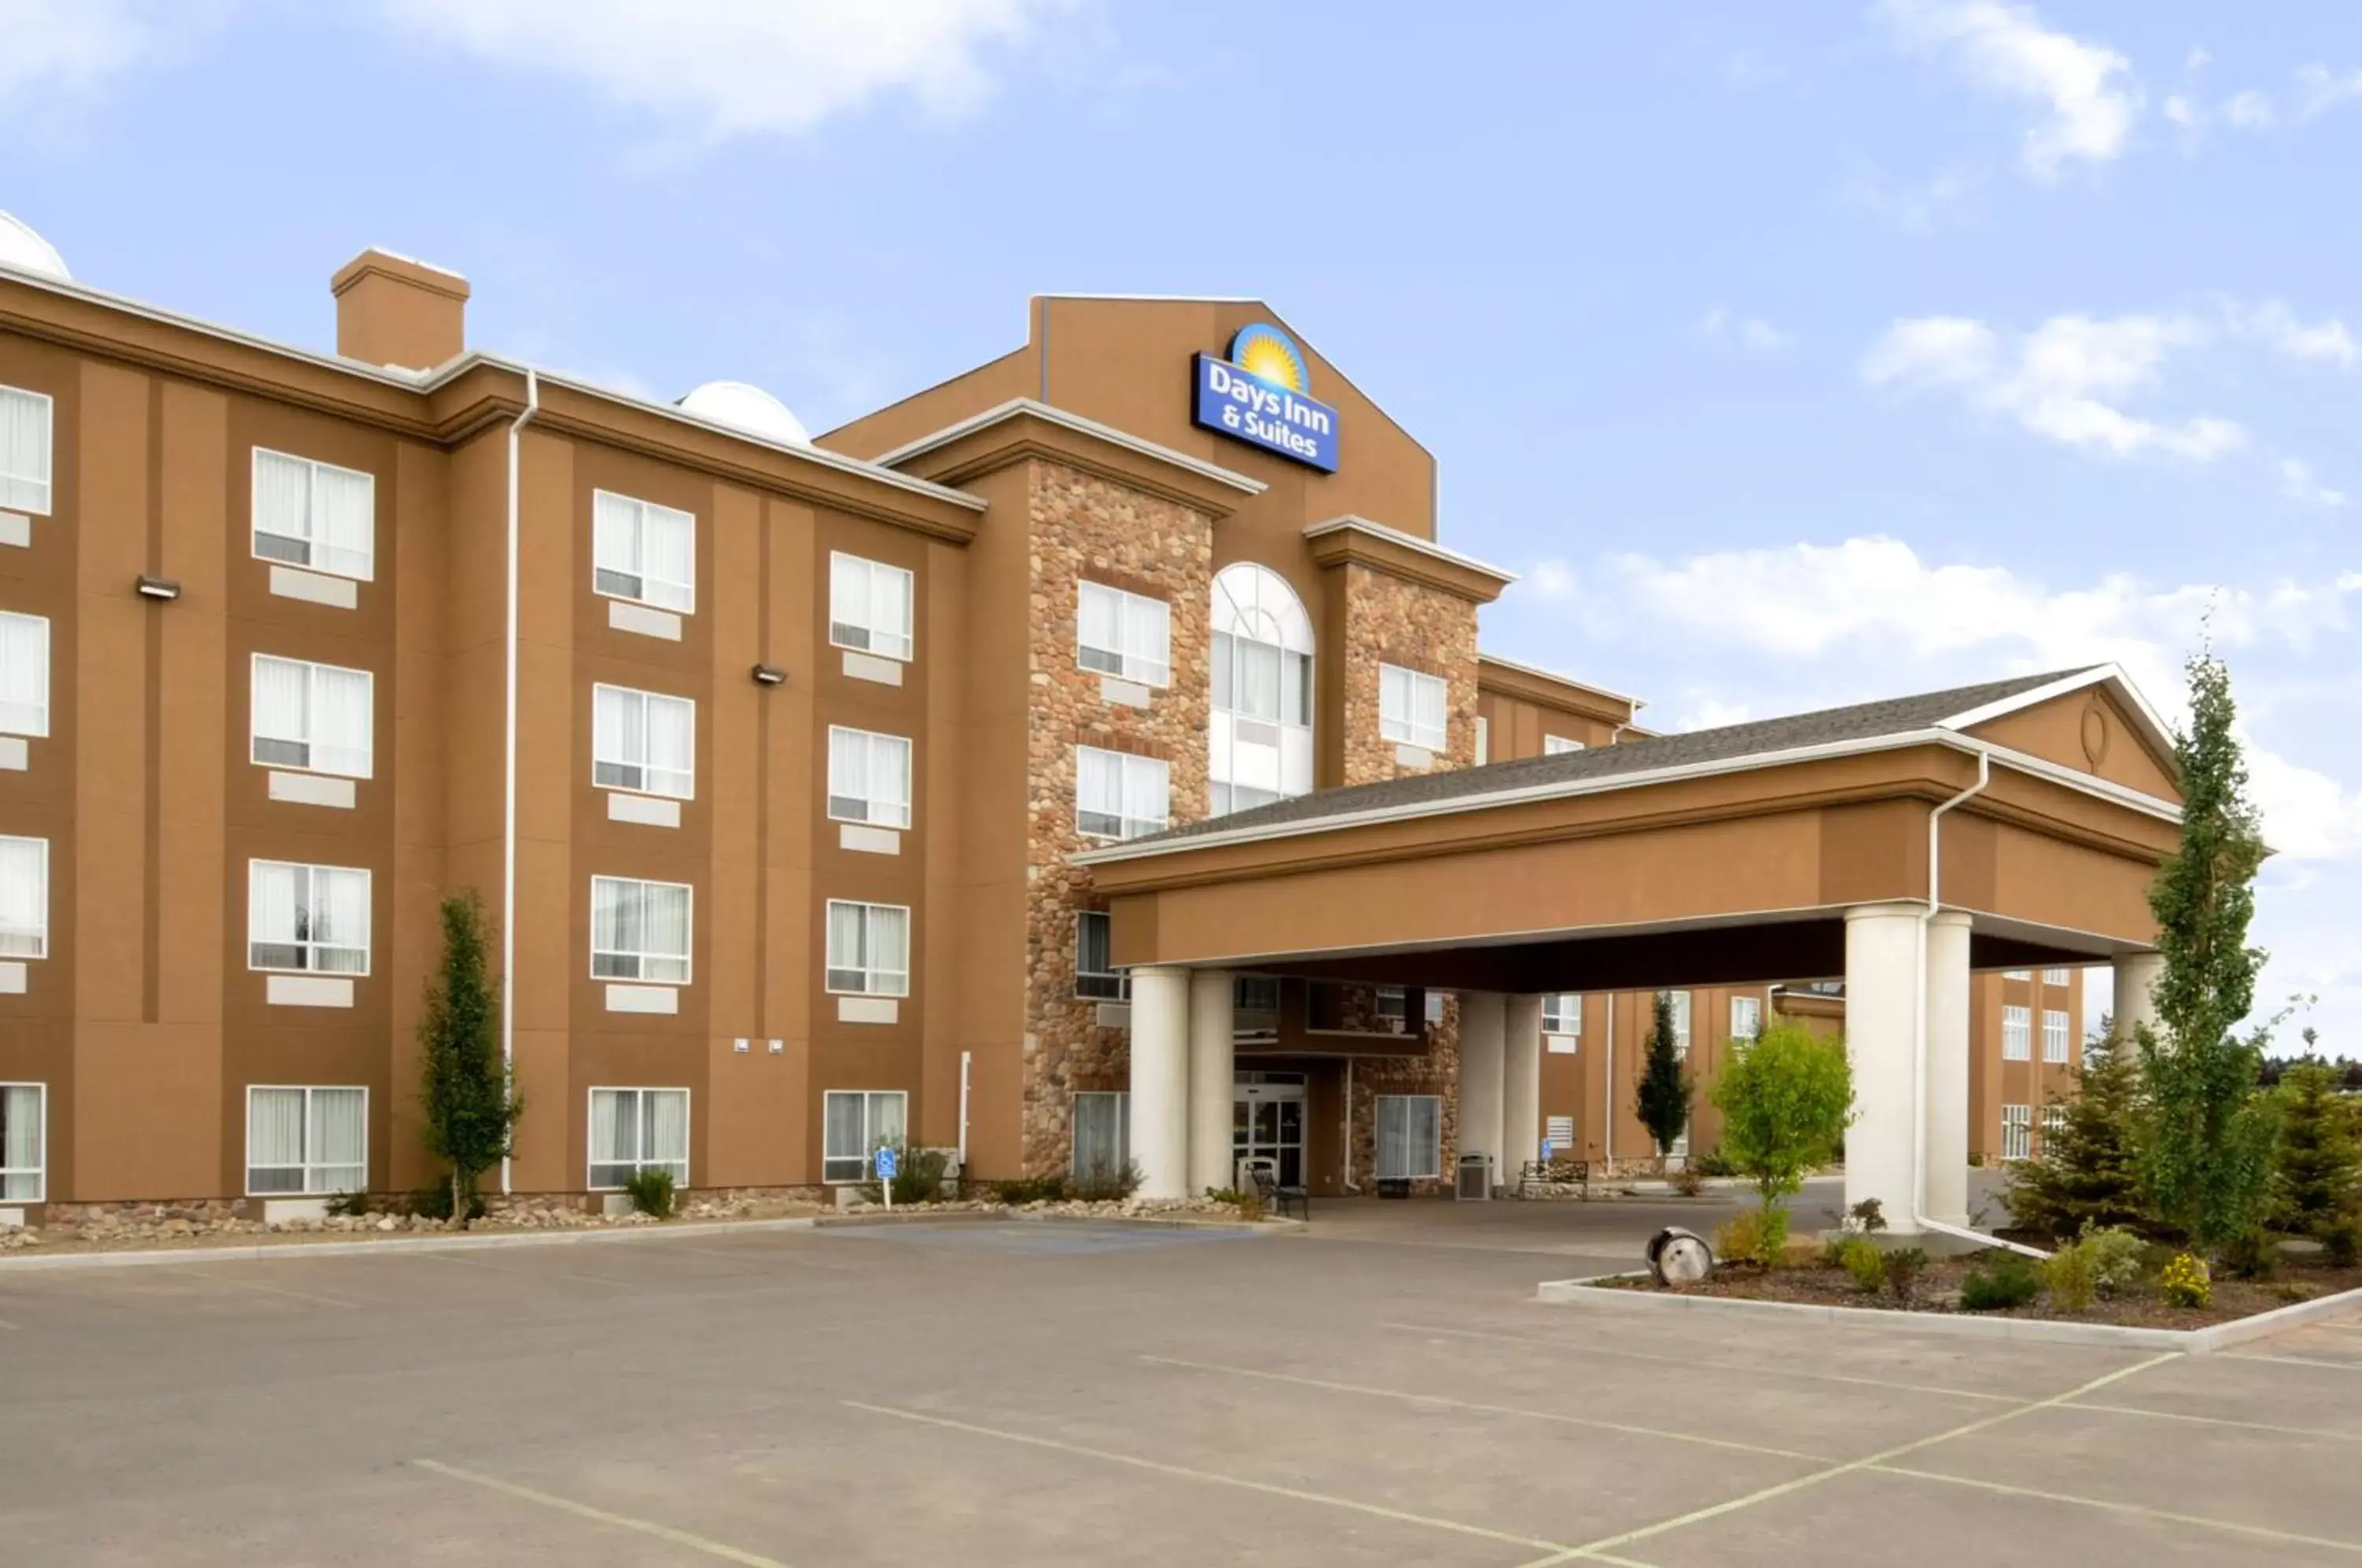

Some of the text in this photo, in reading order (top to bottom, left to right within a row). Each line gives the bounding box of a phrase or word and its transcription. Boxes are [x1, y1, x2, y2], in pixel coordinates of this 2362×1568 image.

[1209, 364, 1329, 435] Days Inn
[1222, 404, 1317, 457] & Suites
